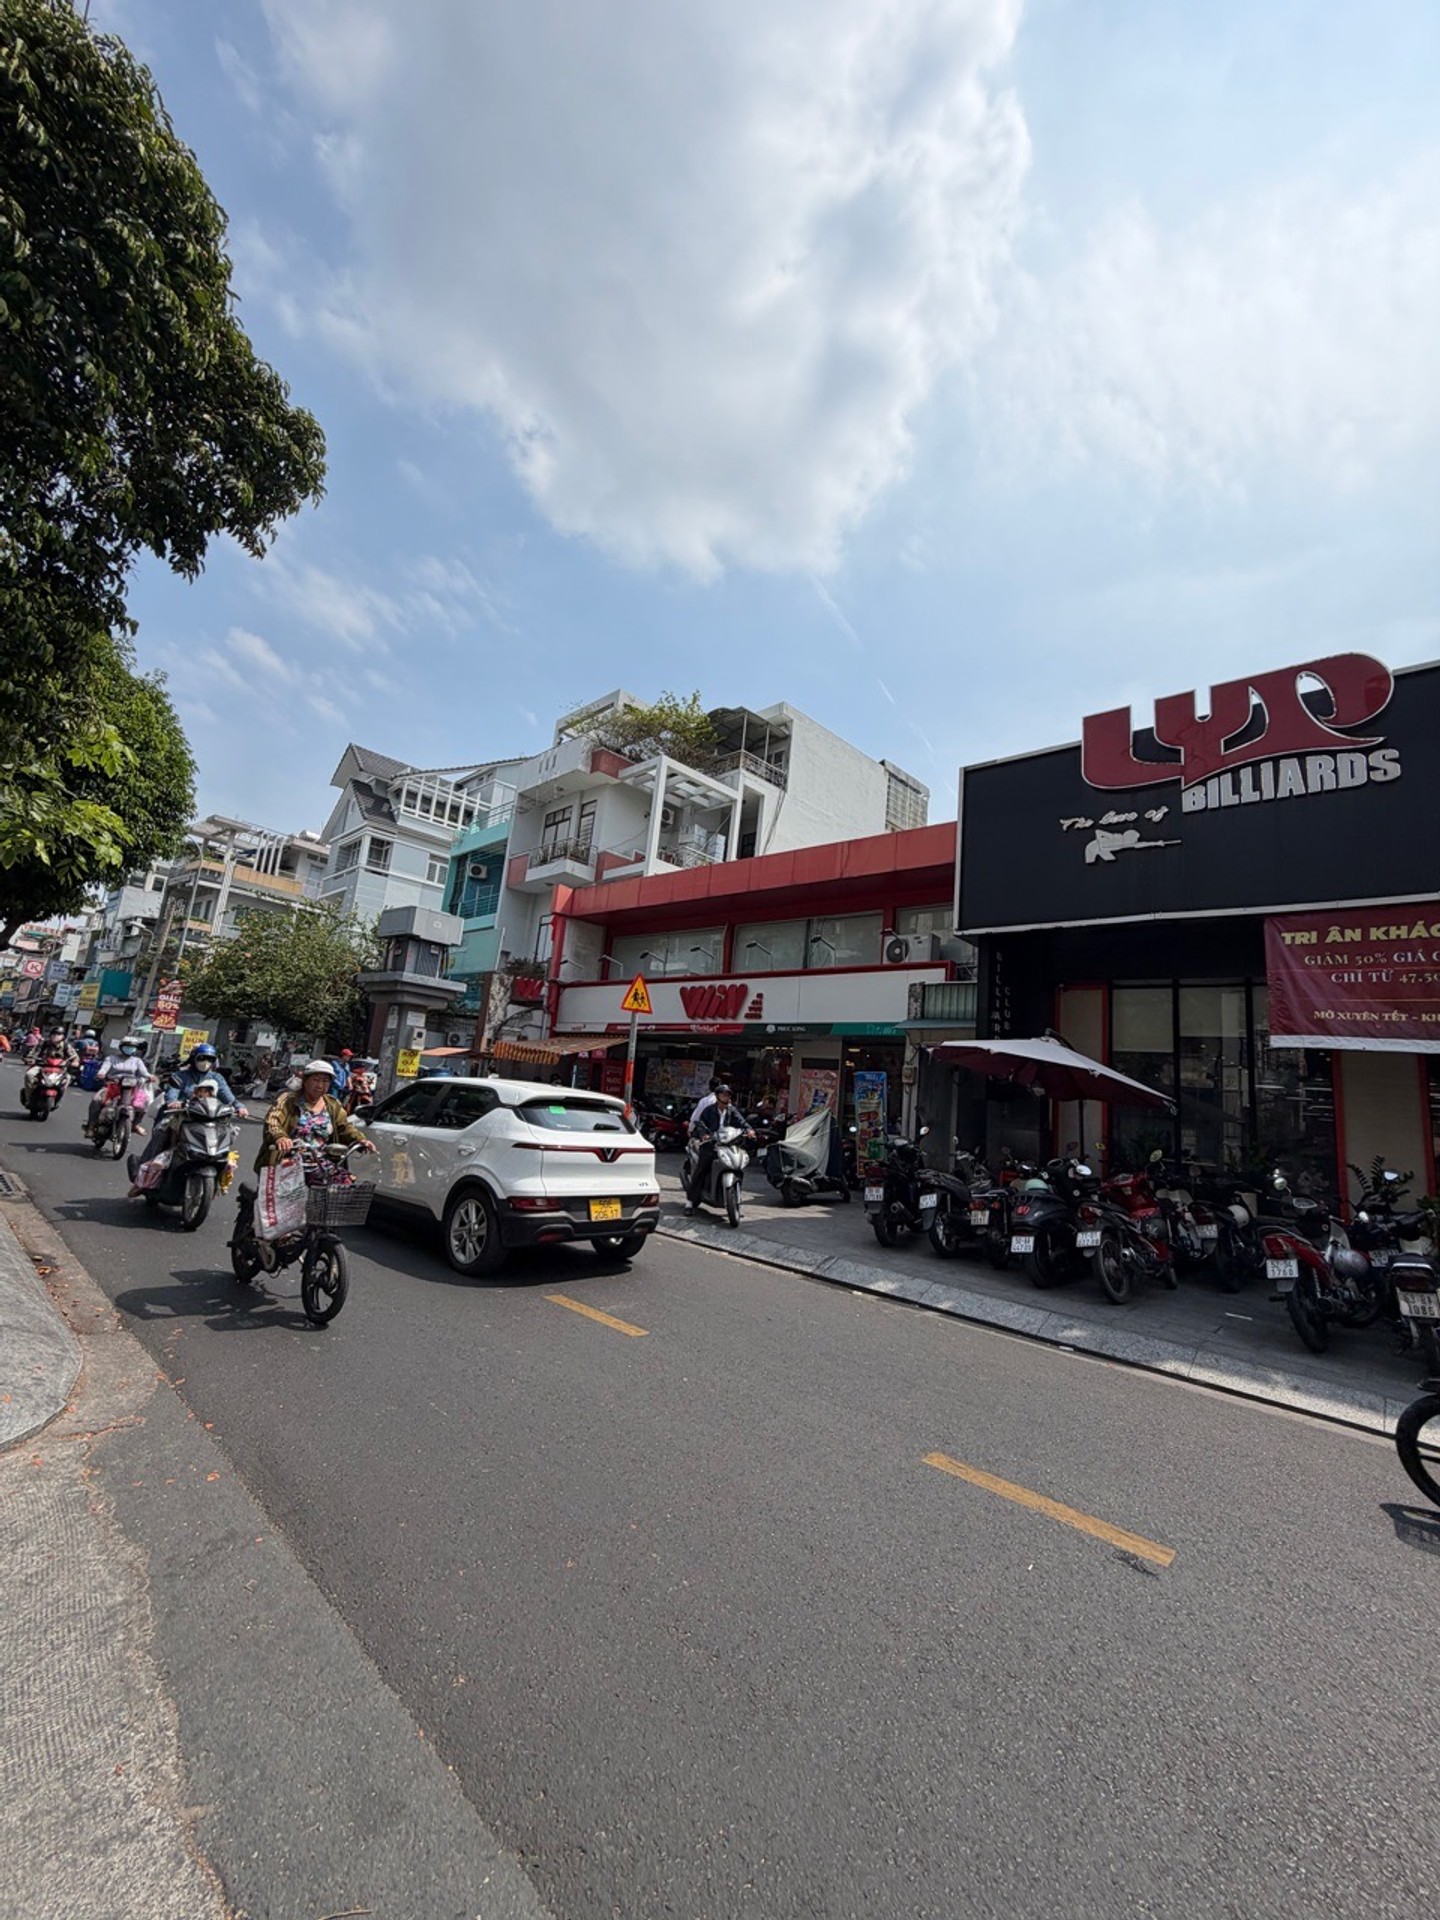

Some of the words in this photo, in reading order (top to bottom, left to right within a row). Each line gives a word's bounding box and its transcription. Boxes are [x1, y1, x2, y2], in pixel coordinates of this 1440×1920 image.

[1182, 749, 1401, 813] BILLIARDS
[1281, 930, 1318, 945] TRI
[1325, 926, 1362, 944] ÂN
[1393, 949, 1426, 963] GIÁ
[1337, 1010, 1380, 1021] XUYÊN
[1381, 1010, 1409, 1022] TẾT
